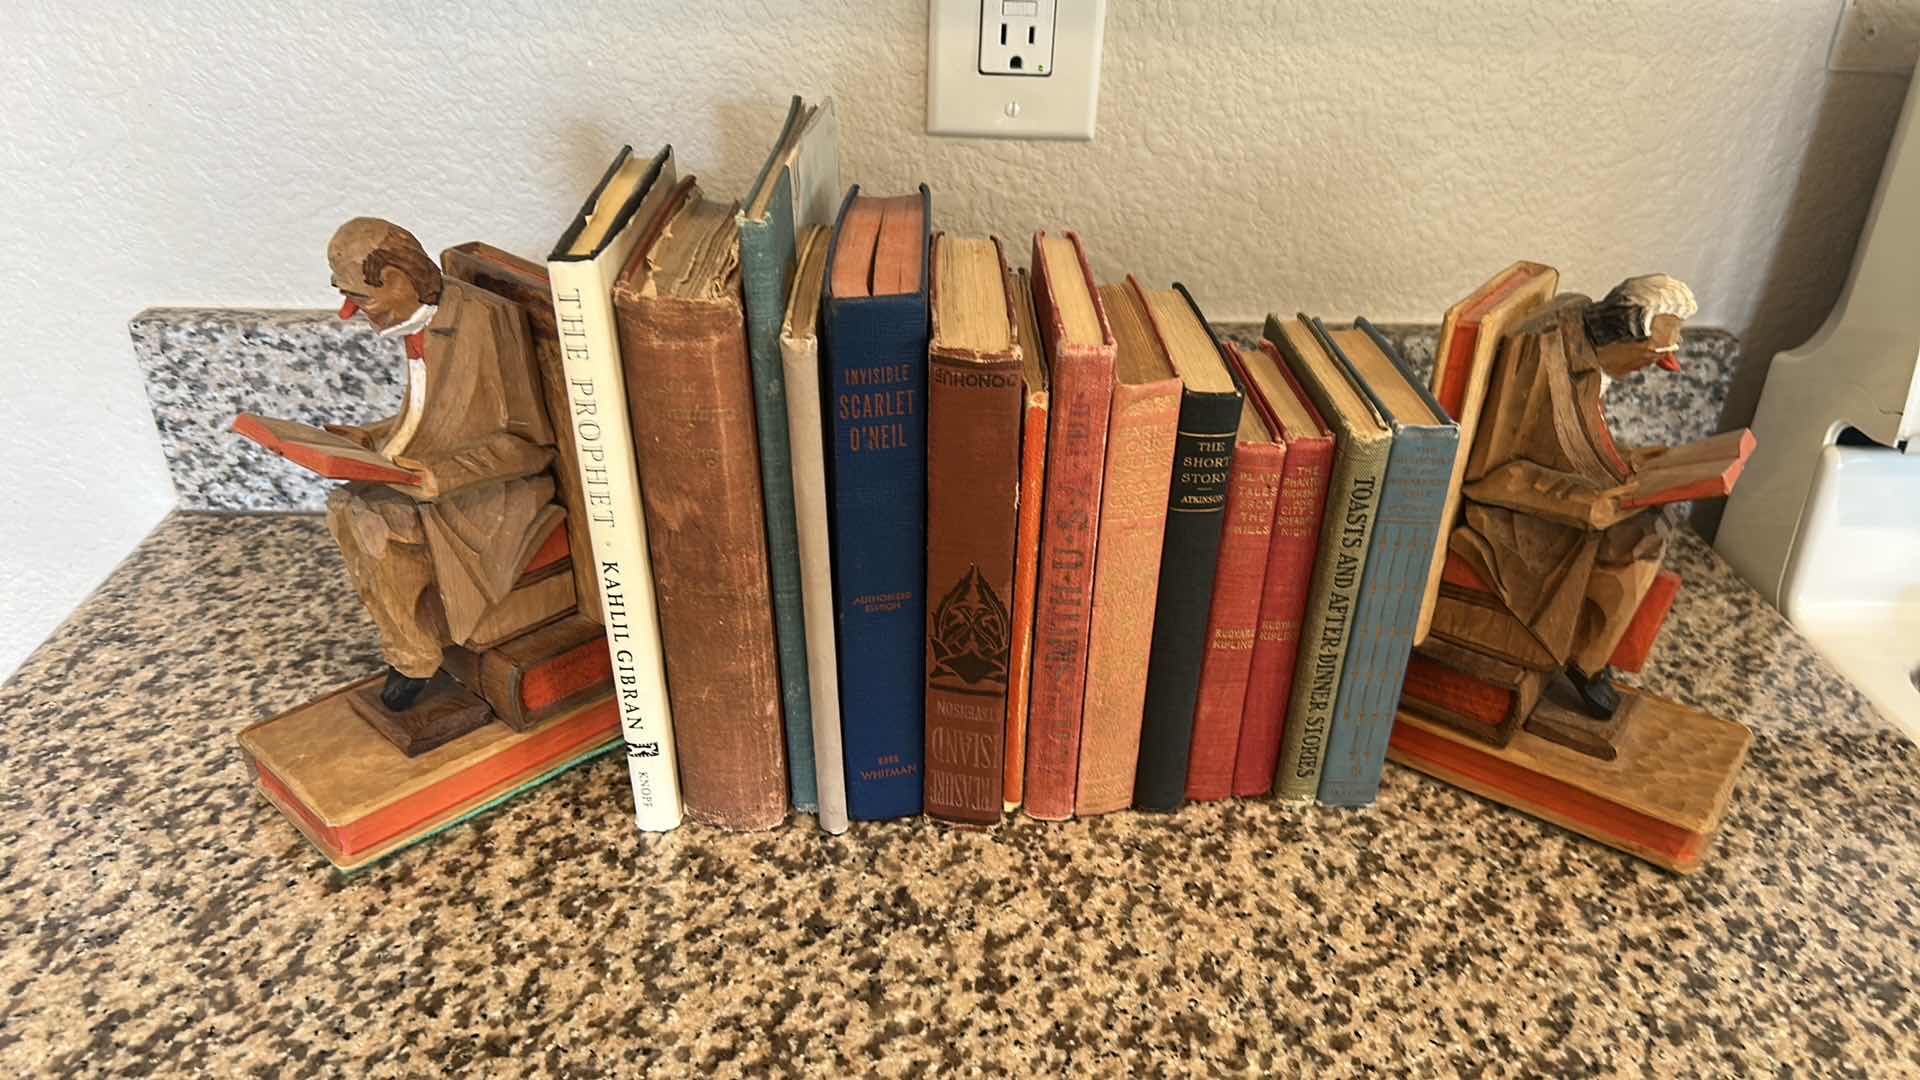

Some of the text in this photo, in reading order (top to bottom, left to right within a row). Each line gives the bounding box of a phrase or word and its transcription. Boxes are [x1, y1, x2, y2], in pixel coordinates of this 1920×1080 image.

[843, 364, 913, 385] INVISIBLE
[558, 288, 615, 528] THE PROPHET
[839, 389, 915, 420] SCARLET
[1198, 442, 1225, 452] THE
[1183, 456, 1231, 468] SHORT
[1180, 473, 1226, 485] STORY
[1181, 495, 1224, 505] ATKINSON
[1238, 486, 1279, 497] TALES
[1240, 511, 1267, 522] THE
[1345, 475, 1376, 548] TOASTS
[1337, 553, 1360, 590] AND
[602, 561, 643, 730] KAHLIL GIBRAN
[1296, 716, 1326, 779] STORIES
